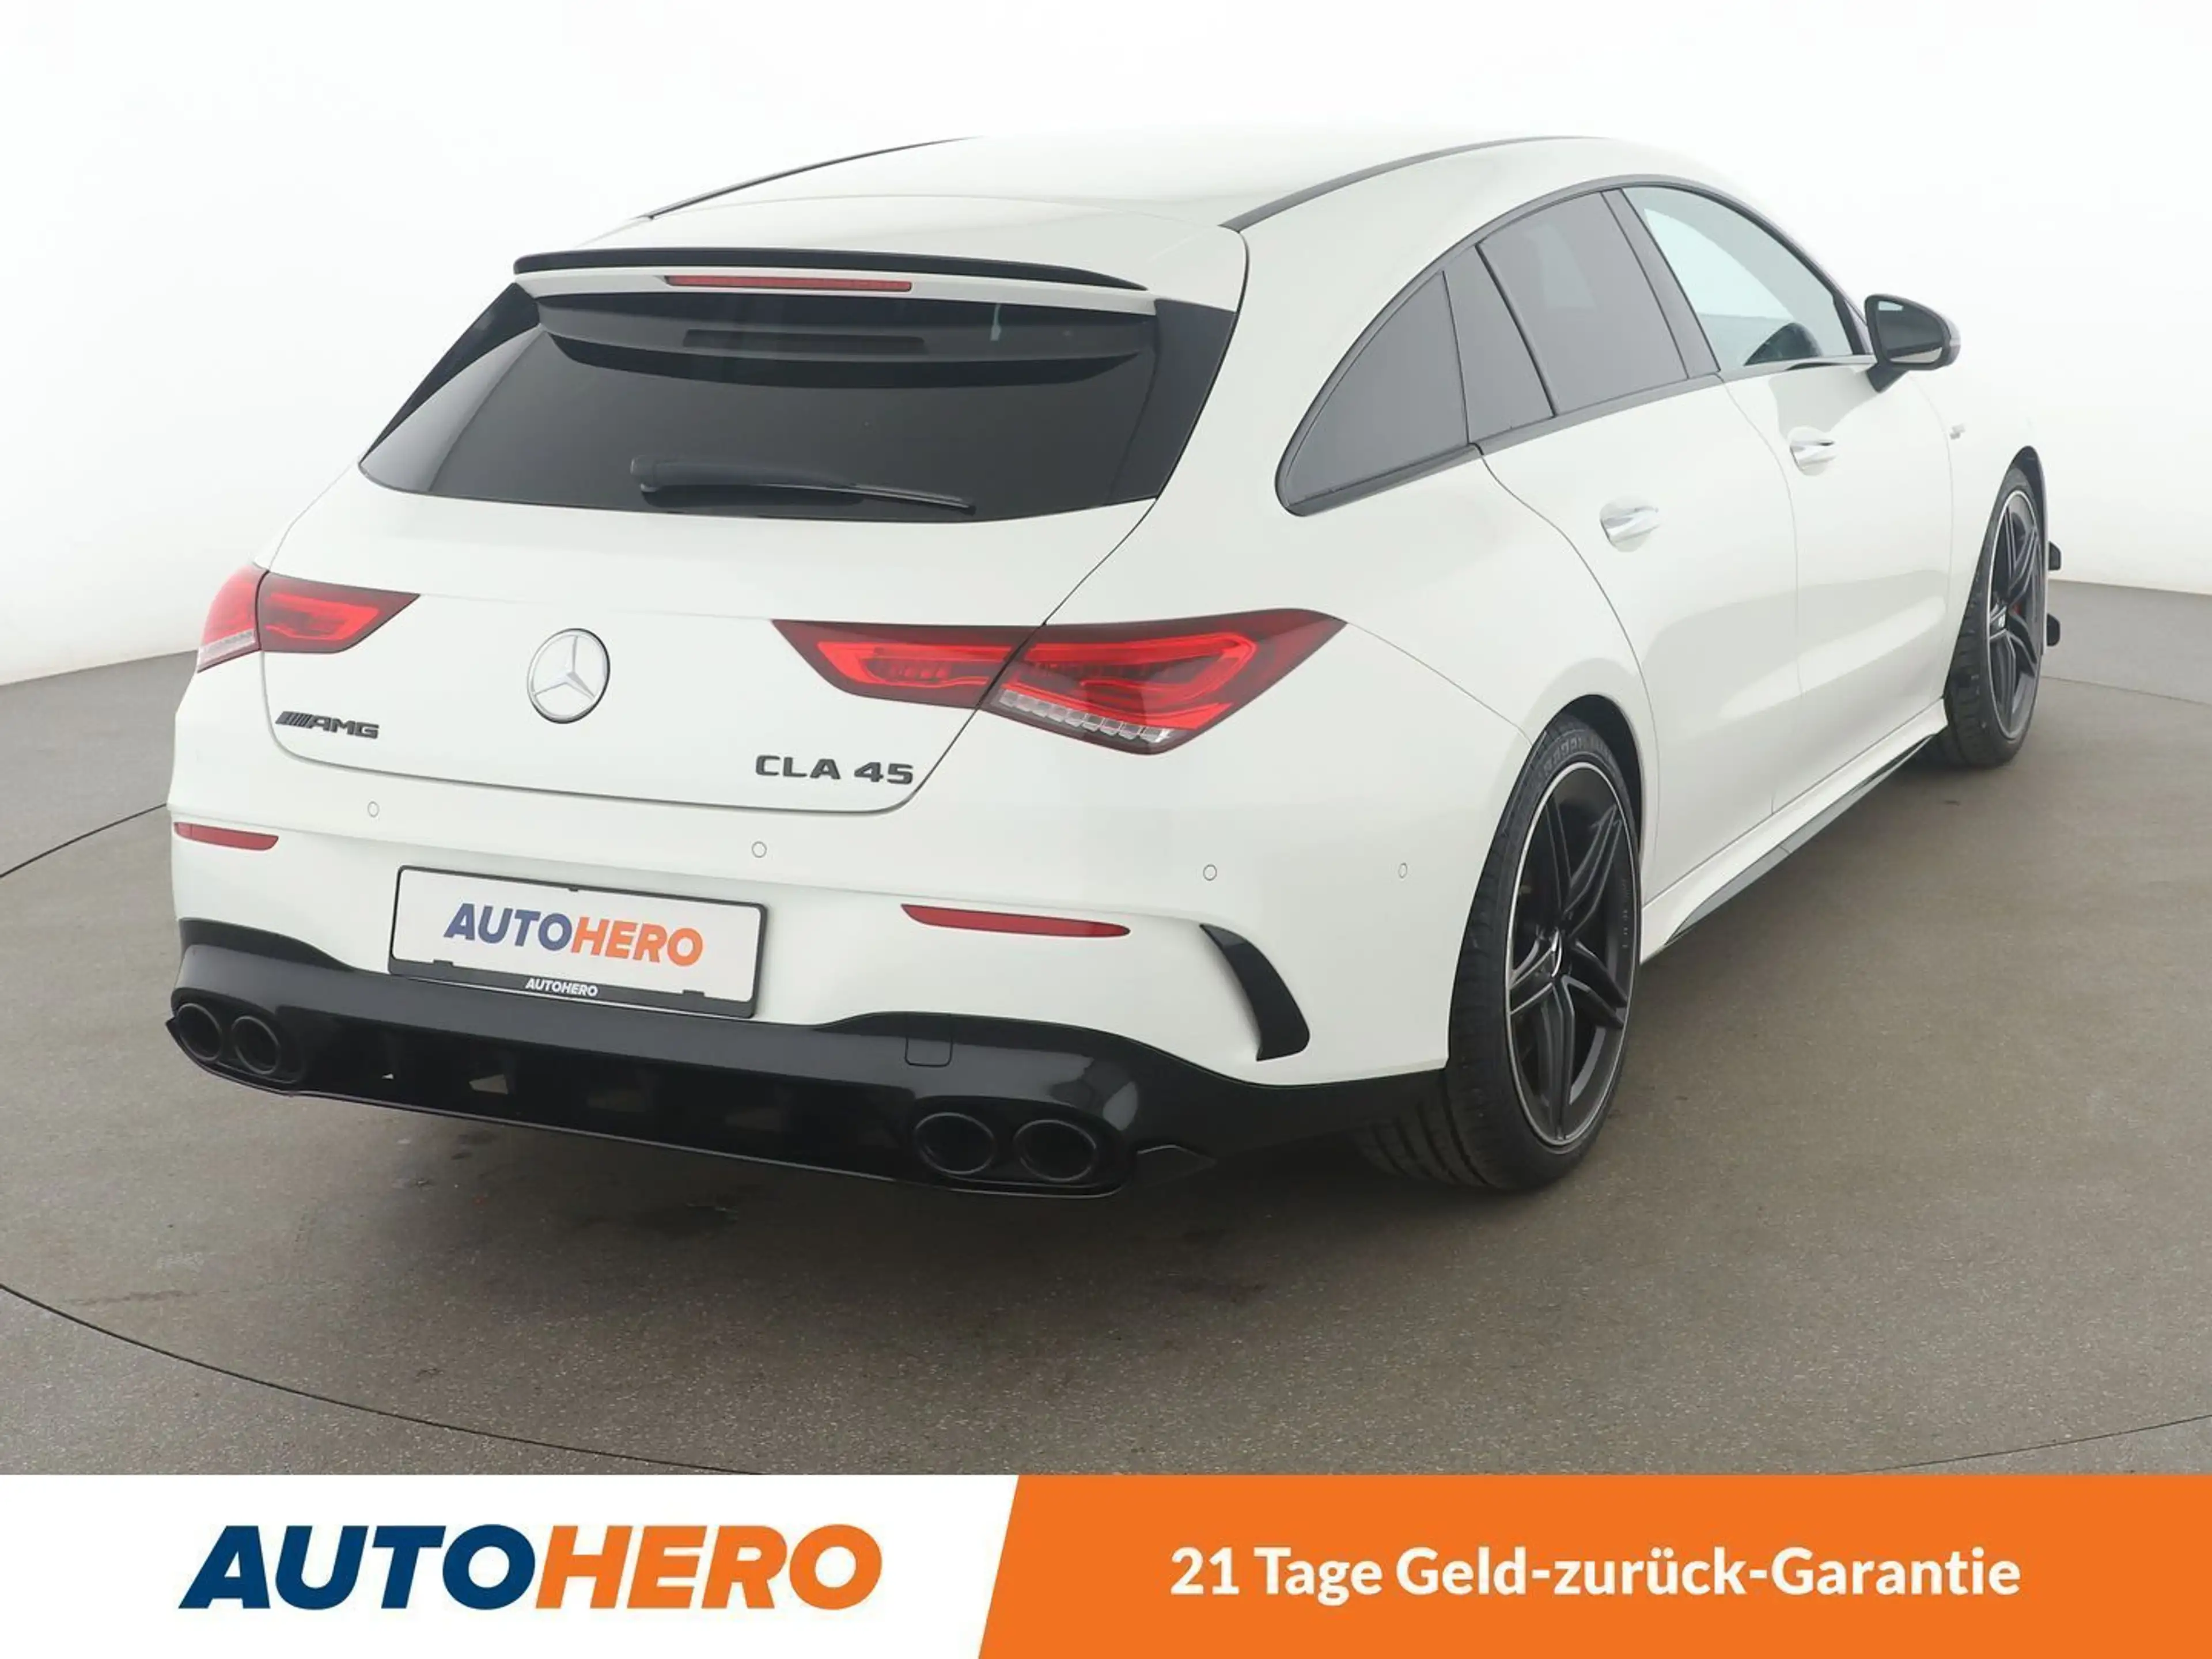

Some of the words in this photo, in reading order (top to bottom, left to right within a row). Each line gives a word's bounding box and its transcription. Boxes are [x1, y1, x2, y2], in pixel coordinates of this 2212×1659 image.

[305, 713, 380, 739] AMG
[755, 755, 841, 780] CLA
[854, 762, 914, 785] 45
[443, 902, 704, 967] AUTOHERO
[525, 978, 599, 997] AUTOHERO
